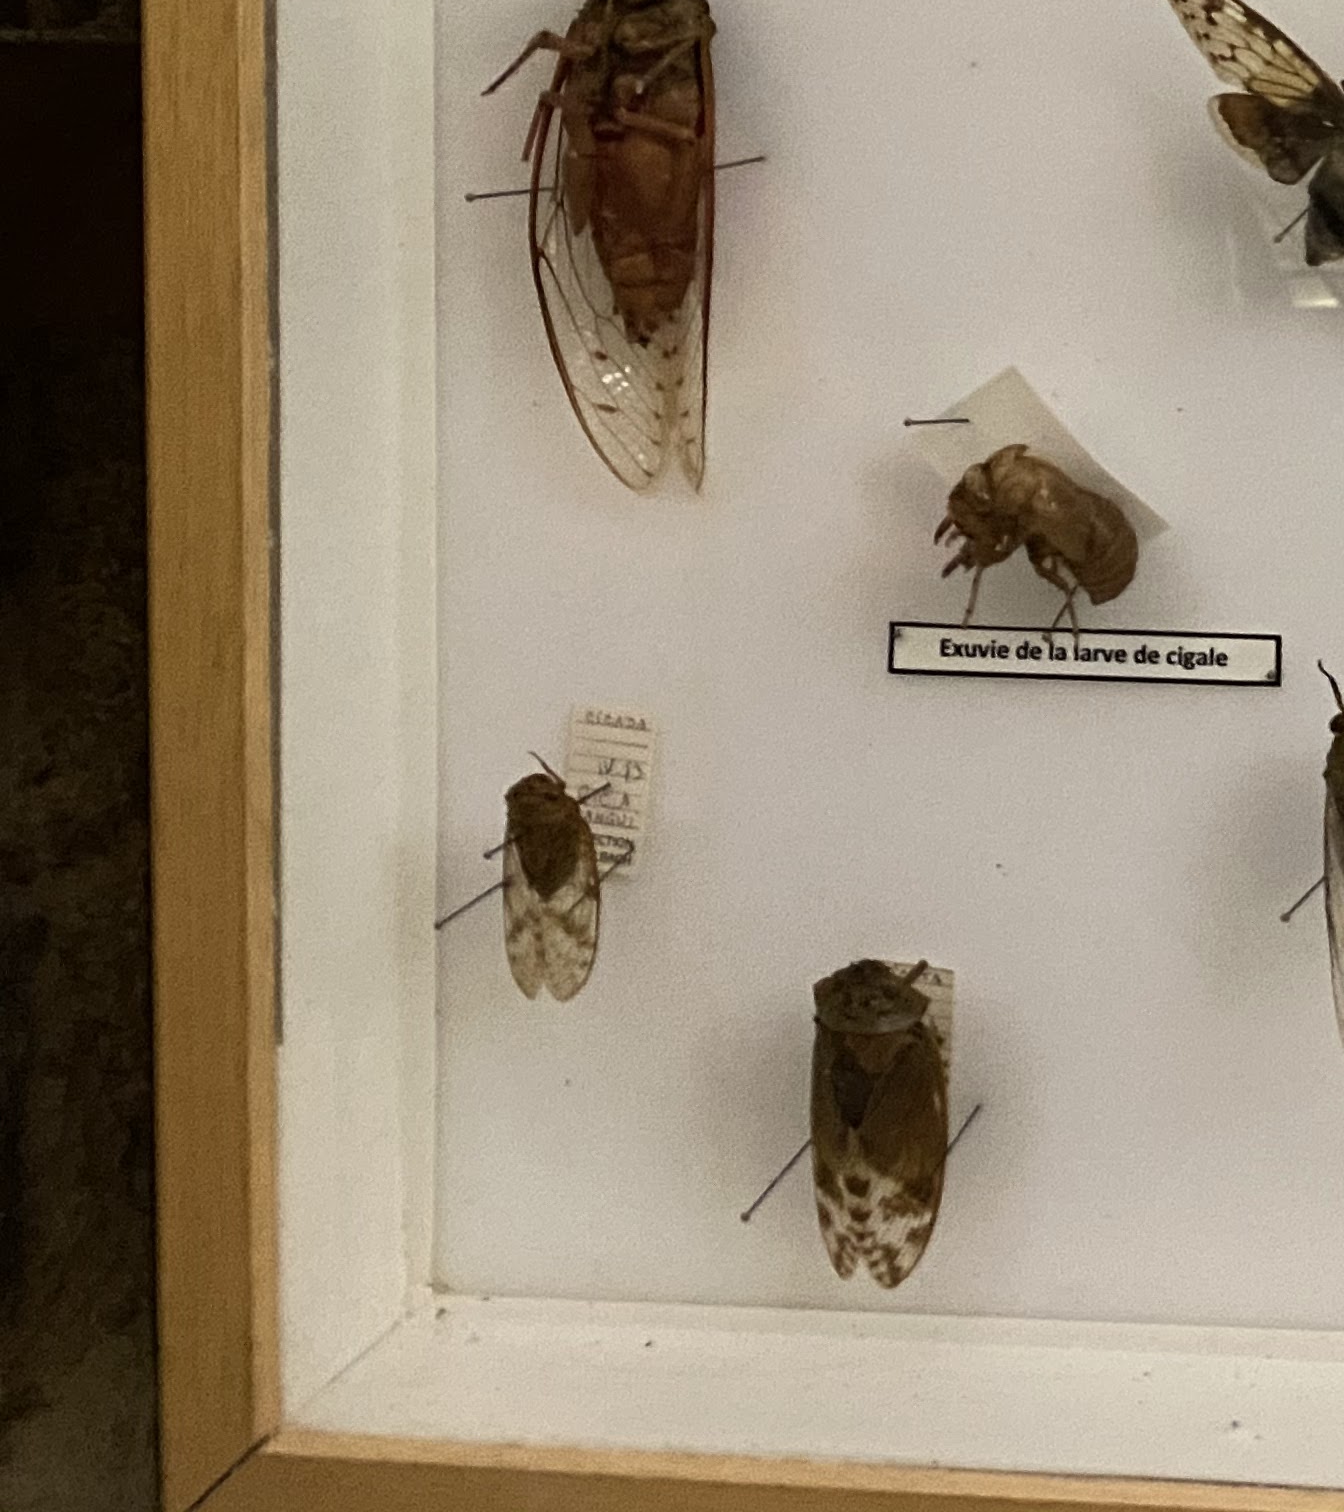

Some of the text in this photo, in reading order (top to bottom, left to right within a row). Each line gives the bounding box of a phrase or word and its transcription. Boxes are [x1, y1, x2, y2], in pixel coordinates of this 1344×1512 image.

[939, 637, 1229, 671] Exuvie de la larve de cigale
